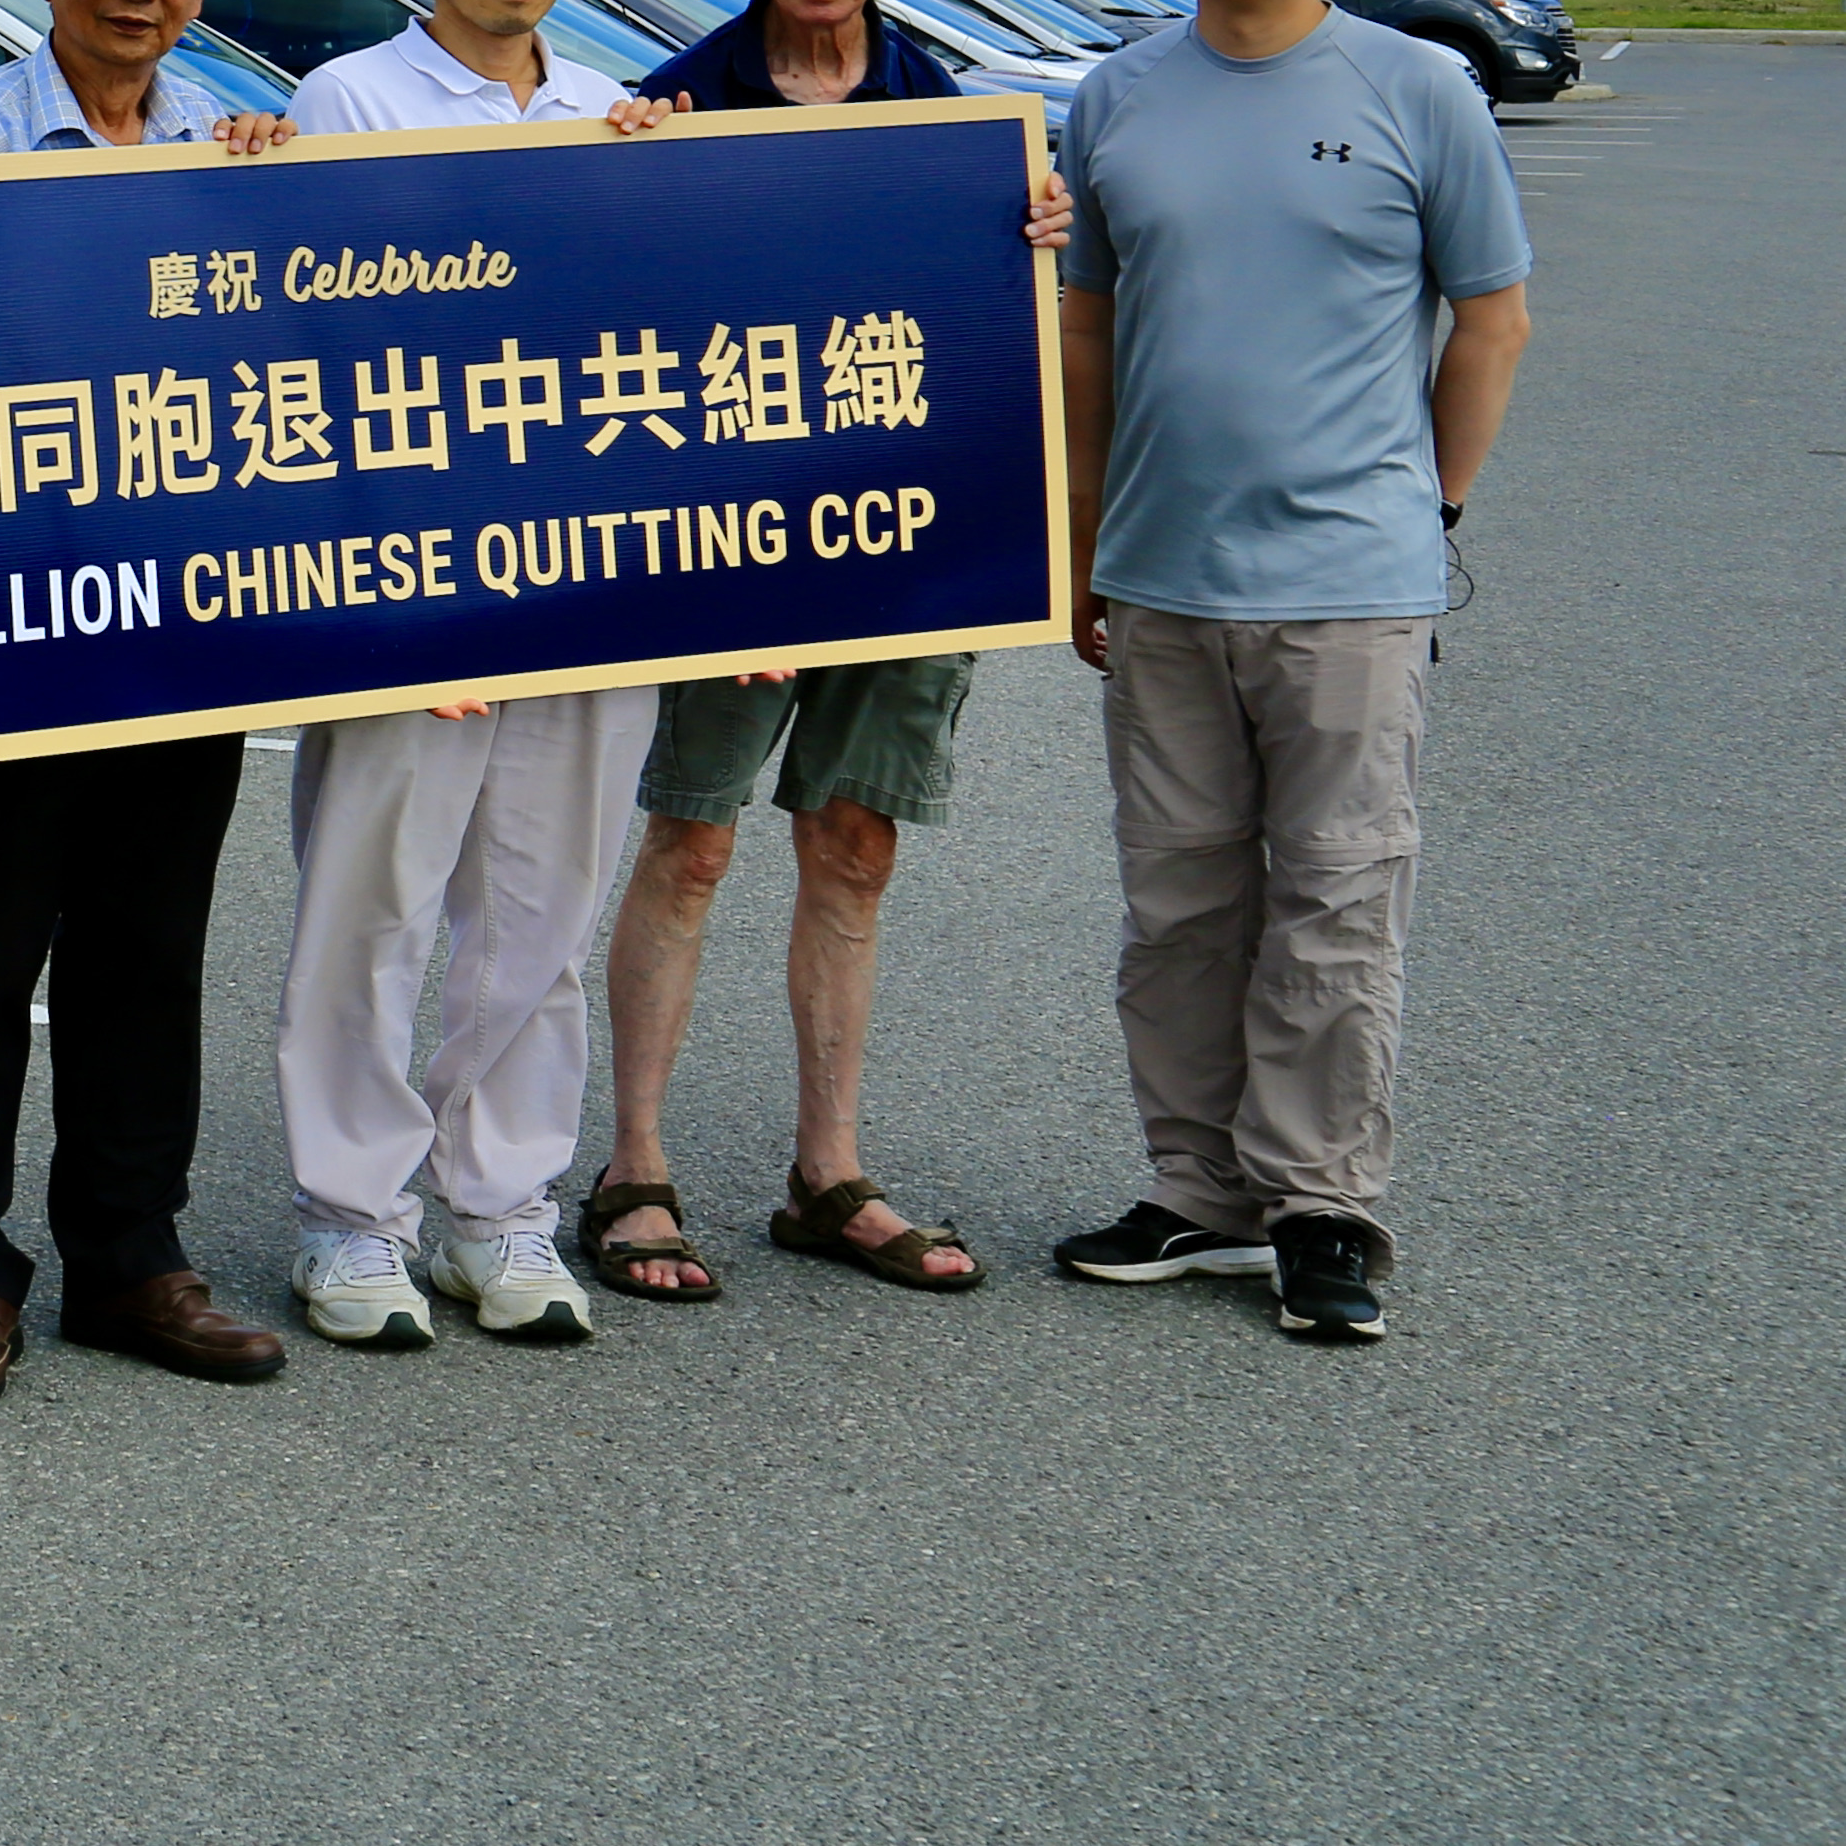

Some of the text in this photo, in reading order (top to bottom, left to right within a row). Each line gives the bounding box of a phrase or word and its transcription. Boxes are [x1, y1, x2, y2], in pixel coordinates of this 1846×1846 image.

[147, 240, 517, 320] 慶祝 Celebrate
[182, 527, 457, 623] CHINESE
[475, 499, 788, 599] QUITTING
[810, 486, 937, 560] CCP
